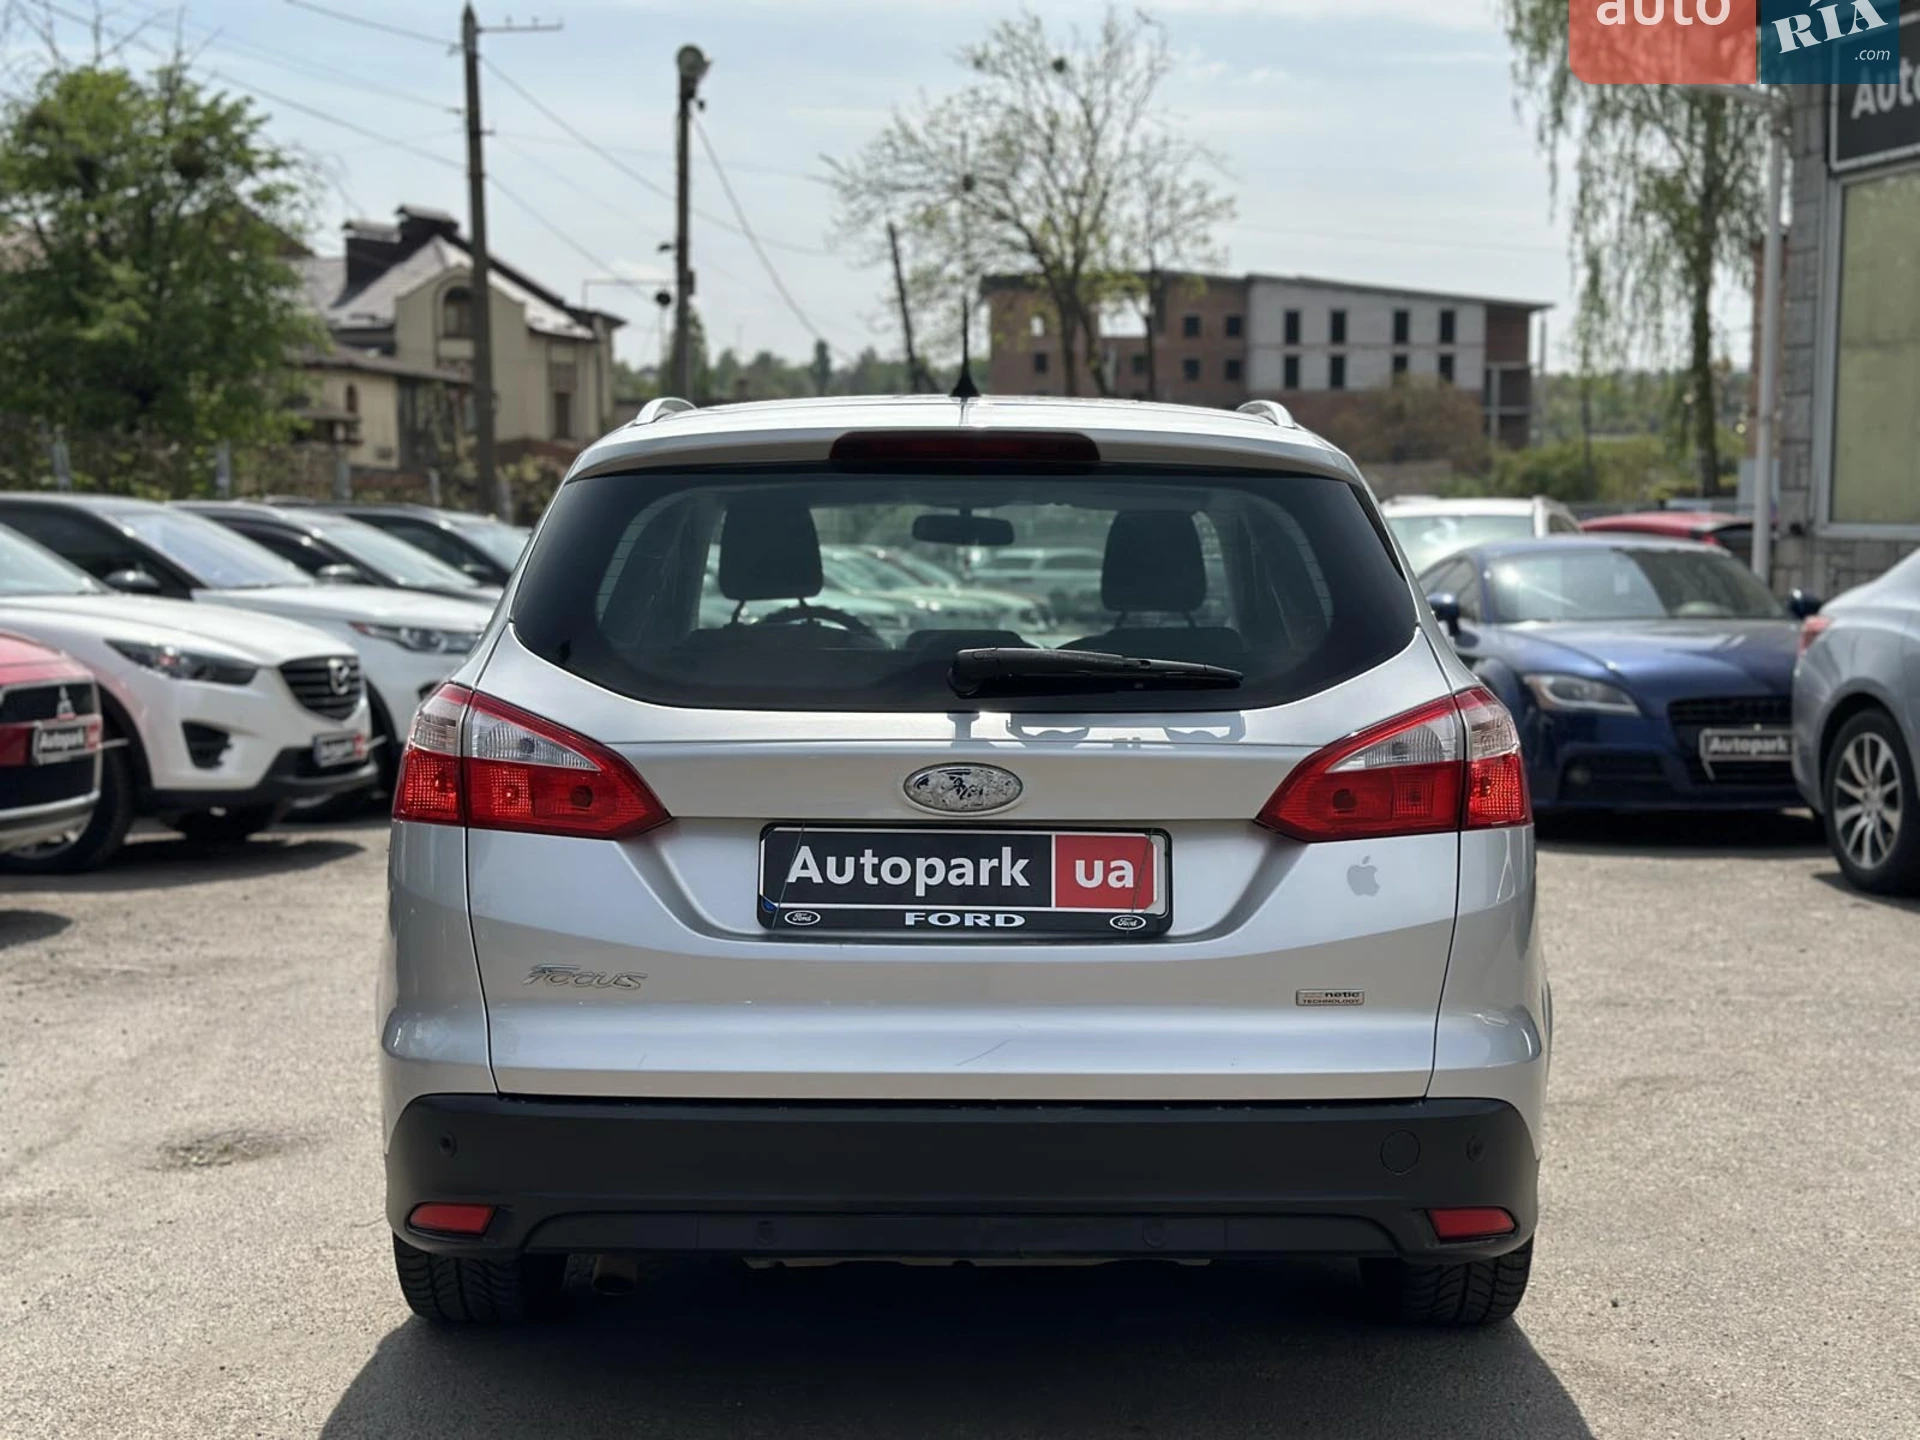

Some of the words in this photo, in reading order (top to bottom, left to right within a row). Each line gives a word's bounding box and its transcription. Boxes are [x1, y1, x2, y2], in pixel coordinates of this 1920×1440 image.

[1708, 736, 1789, 756] Autopark
[787, 844, 1030, 896] Autopark
[1074, 859, 1136, 889] ua
[904, 912, 1026, 928] FORD
